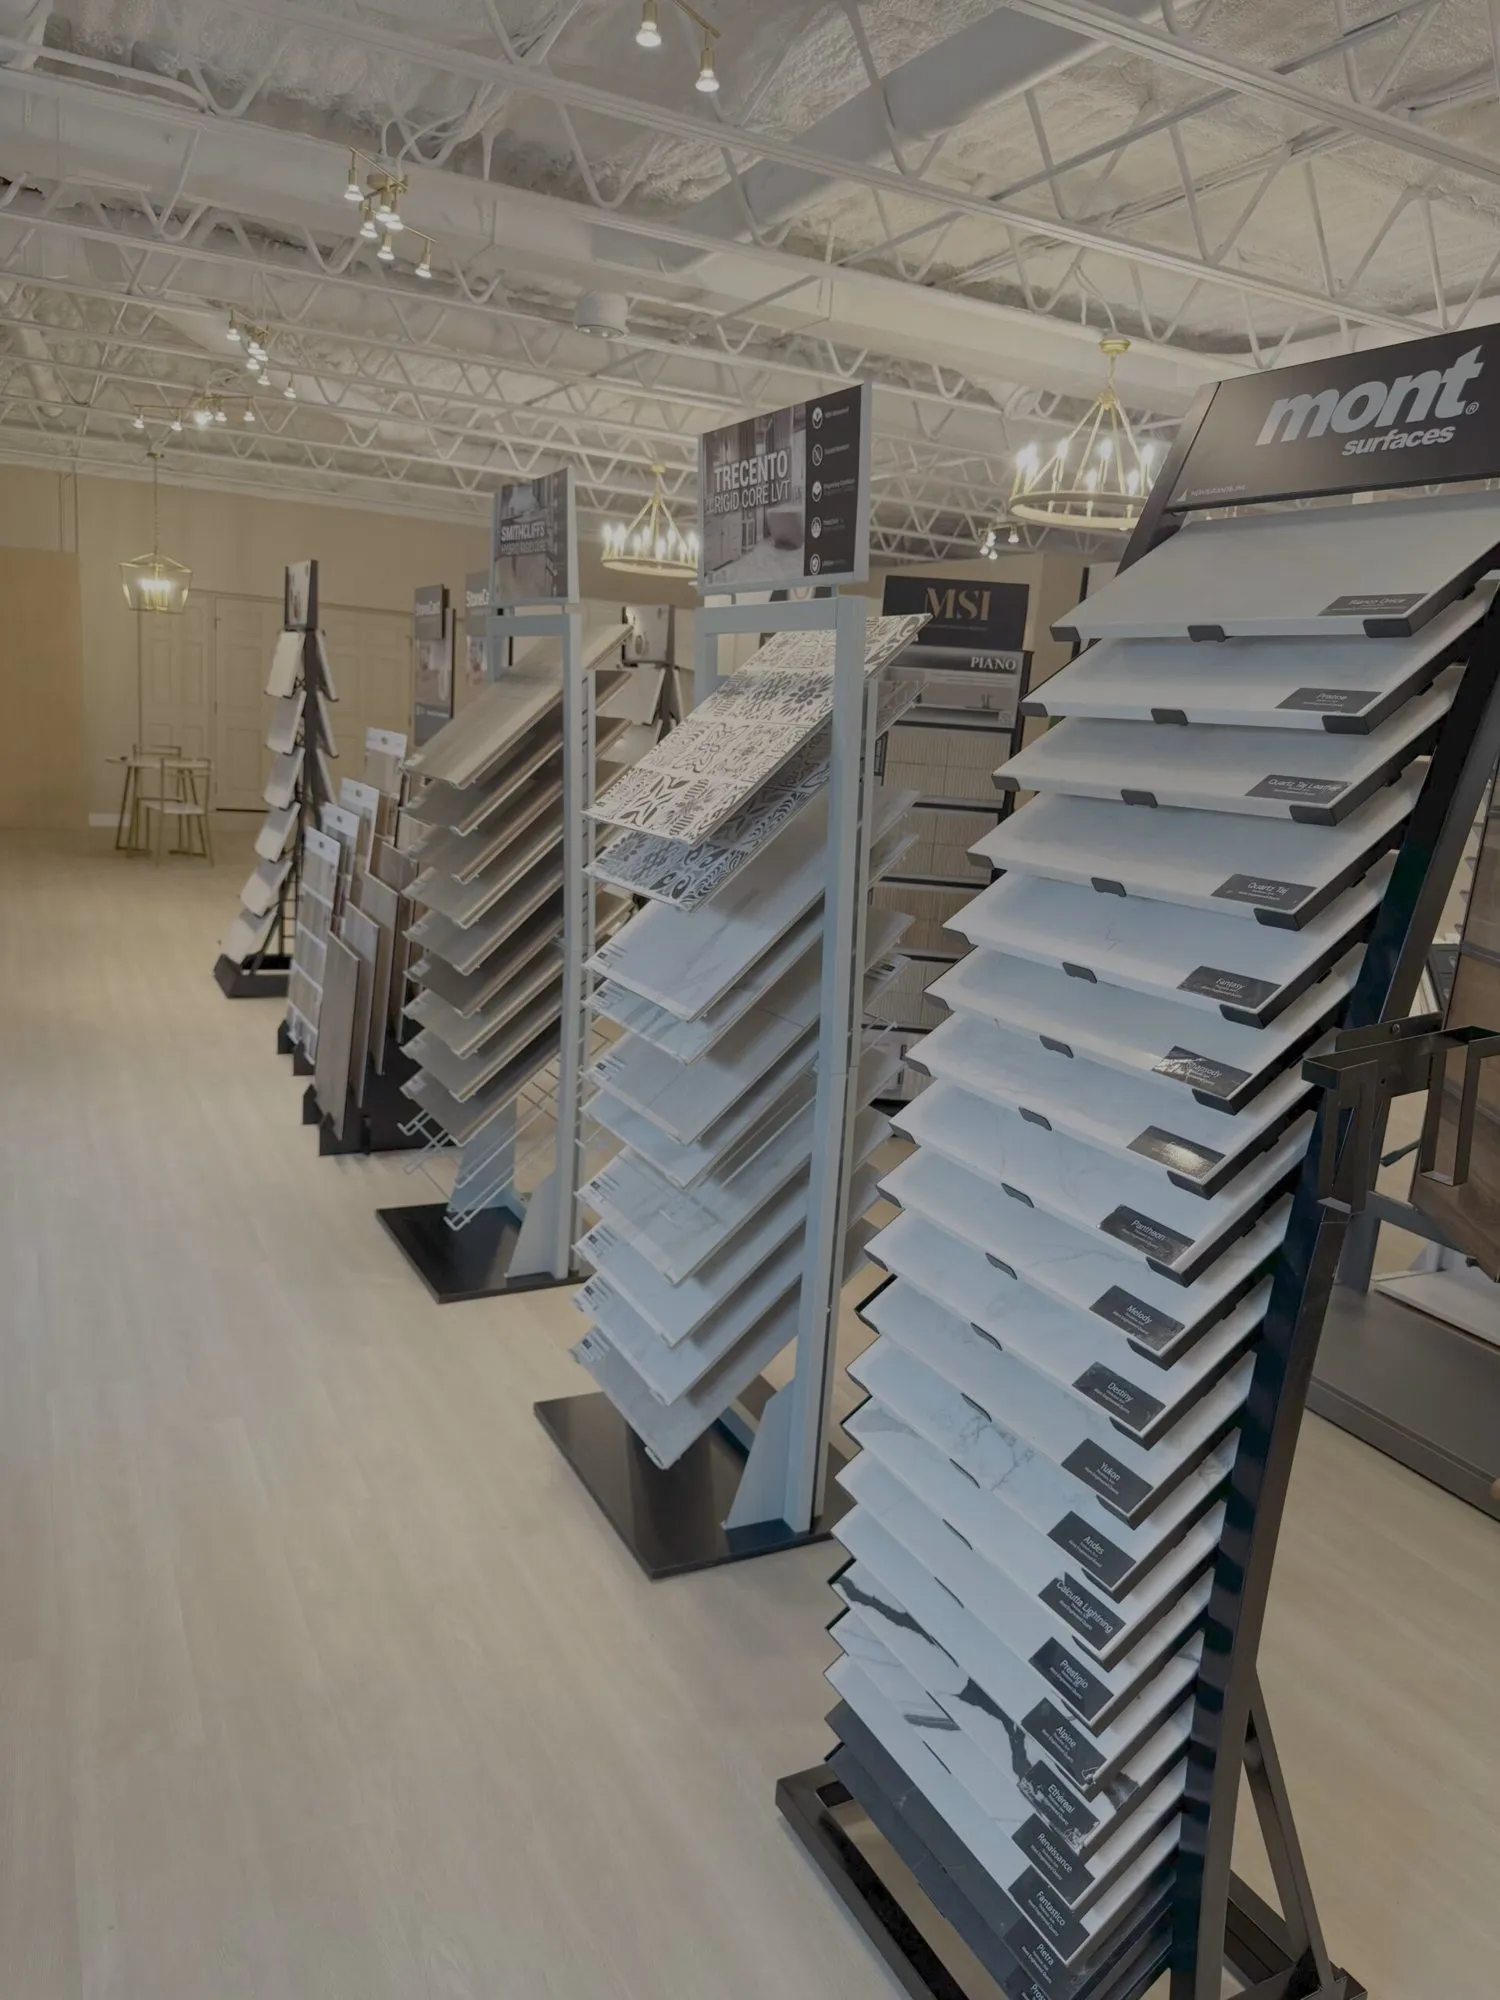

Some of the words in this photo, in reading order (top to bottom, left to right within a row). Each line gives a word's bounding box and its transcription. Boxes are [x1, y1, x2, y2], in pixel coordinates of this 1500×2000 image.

[1342, 425, 1456, 456] surfaces
[714, 449, 788, 493] TRECENTO
[714, 490, 740, 513] RIGID
[742, 484, 769, 508] CORE
[771, 479, 791, 502] LVT
[925, 587, 992, 622] MSI
[970, 656, 1016, 671] PIANO
[1247, 881, 1275, 892] Quartz
[1216, 978, 1244, 990] Fantasy
[1131, 1219, 1167, 1241] Pantheon
[1126, 1304, 1152, 1326] Melody
[1107, 1381, 1134, 1403] Destiny
[1100, 1461, 1121, 1482] Yukon
[1083, 1535, 1105, 1556] Andes
[1082, 1603, 1113, 1634] Lightning
[1059, 1659, 1089, 1689] Prestigio
[1056, 1725, 1077, 1749] Alpine
[1048, 1783, 1075, 1814] Ethereal
[1036, 1832, 1073, 1874] Renaissance
[1036, 1891, 1065, 1926] Fantastico
[1036, 1943, 1055, 1966] Pietra
